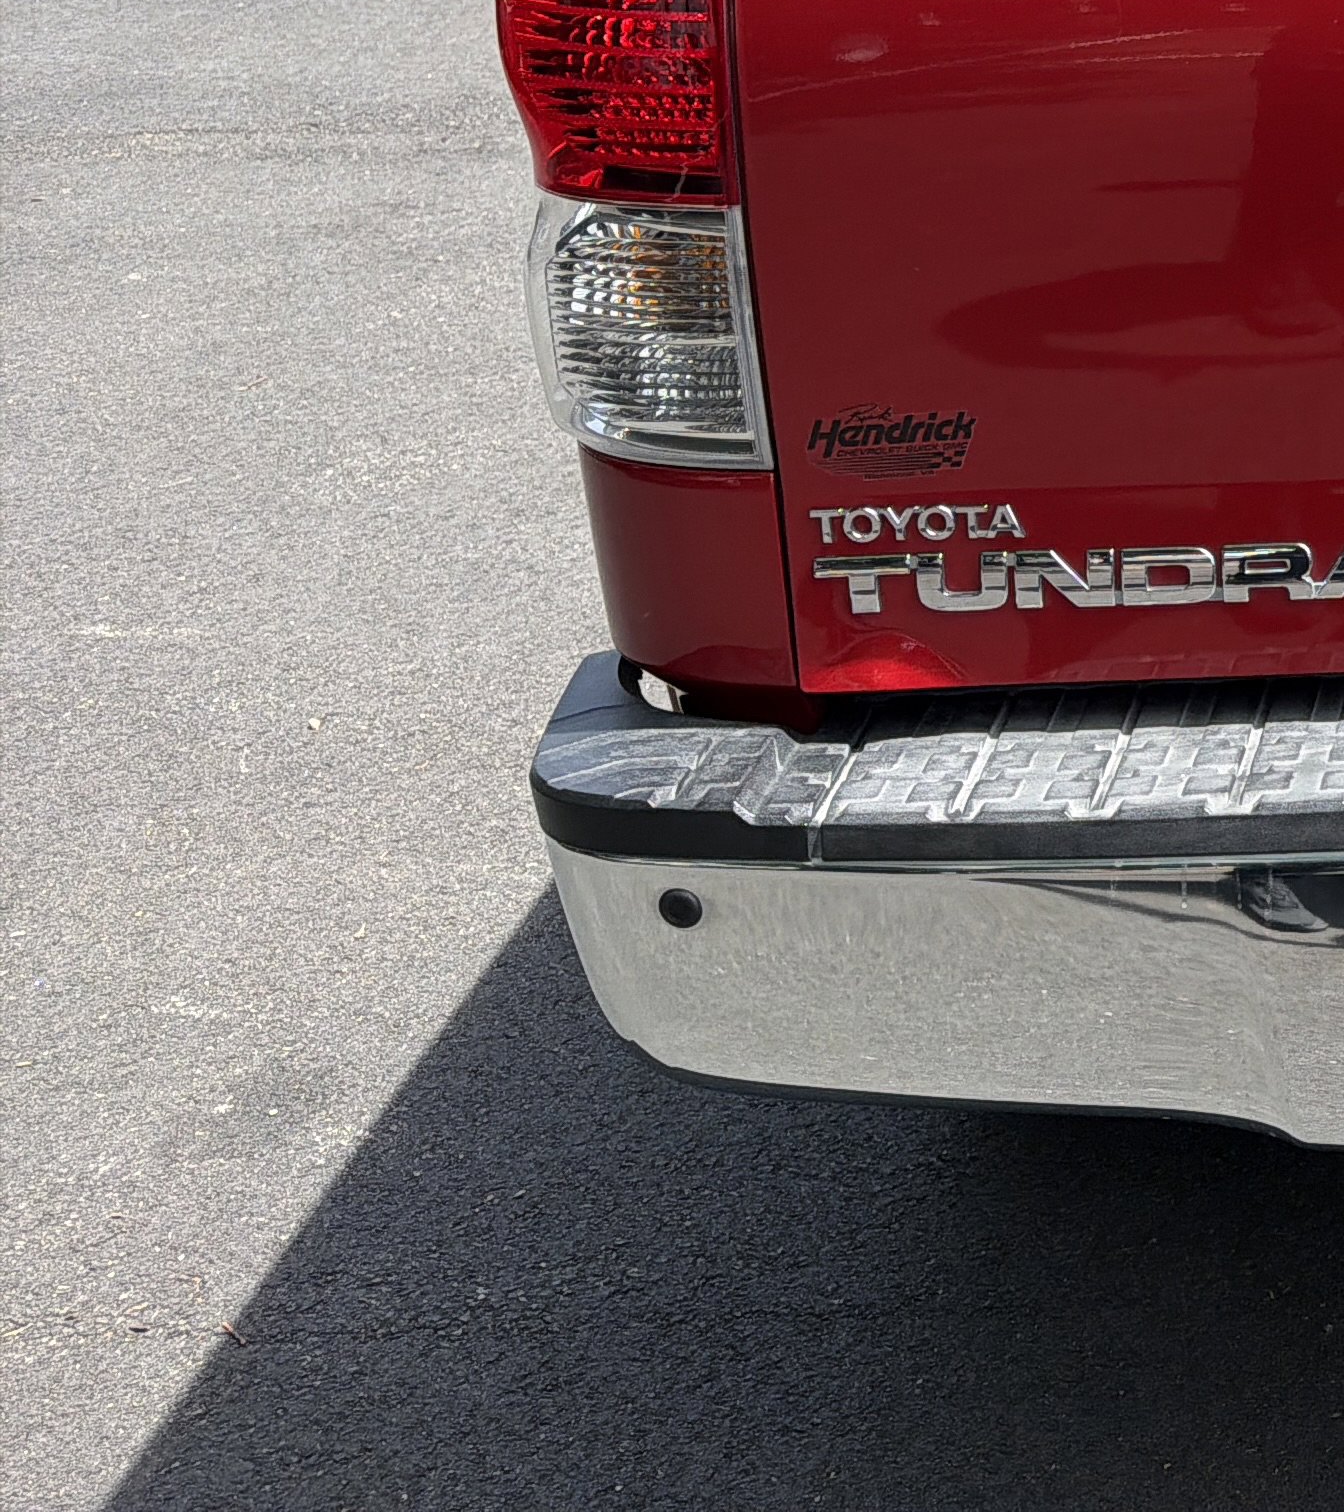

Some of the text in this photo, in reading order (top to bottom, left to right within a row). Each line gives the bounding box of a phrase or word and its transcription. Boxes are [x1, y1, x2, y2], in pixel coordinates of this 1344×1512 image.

[807, 411, 977, 459] Hendrick
[836, 441, 969, 458] CHEVROLET BUICK GMC
[809, 503, 1027, 545] TOYOTA
